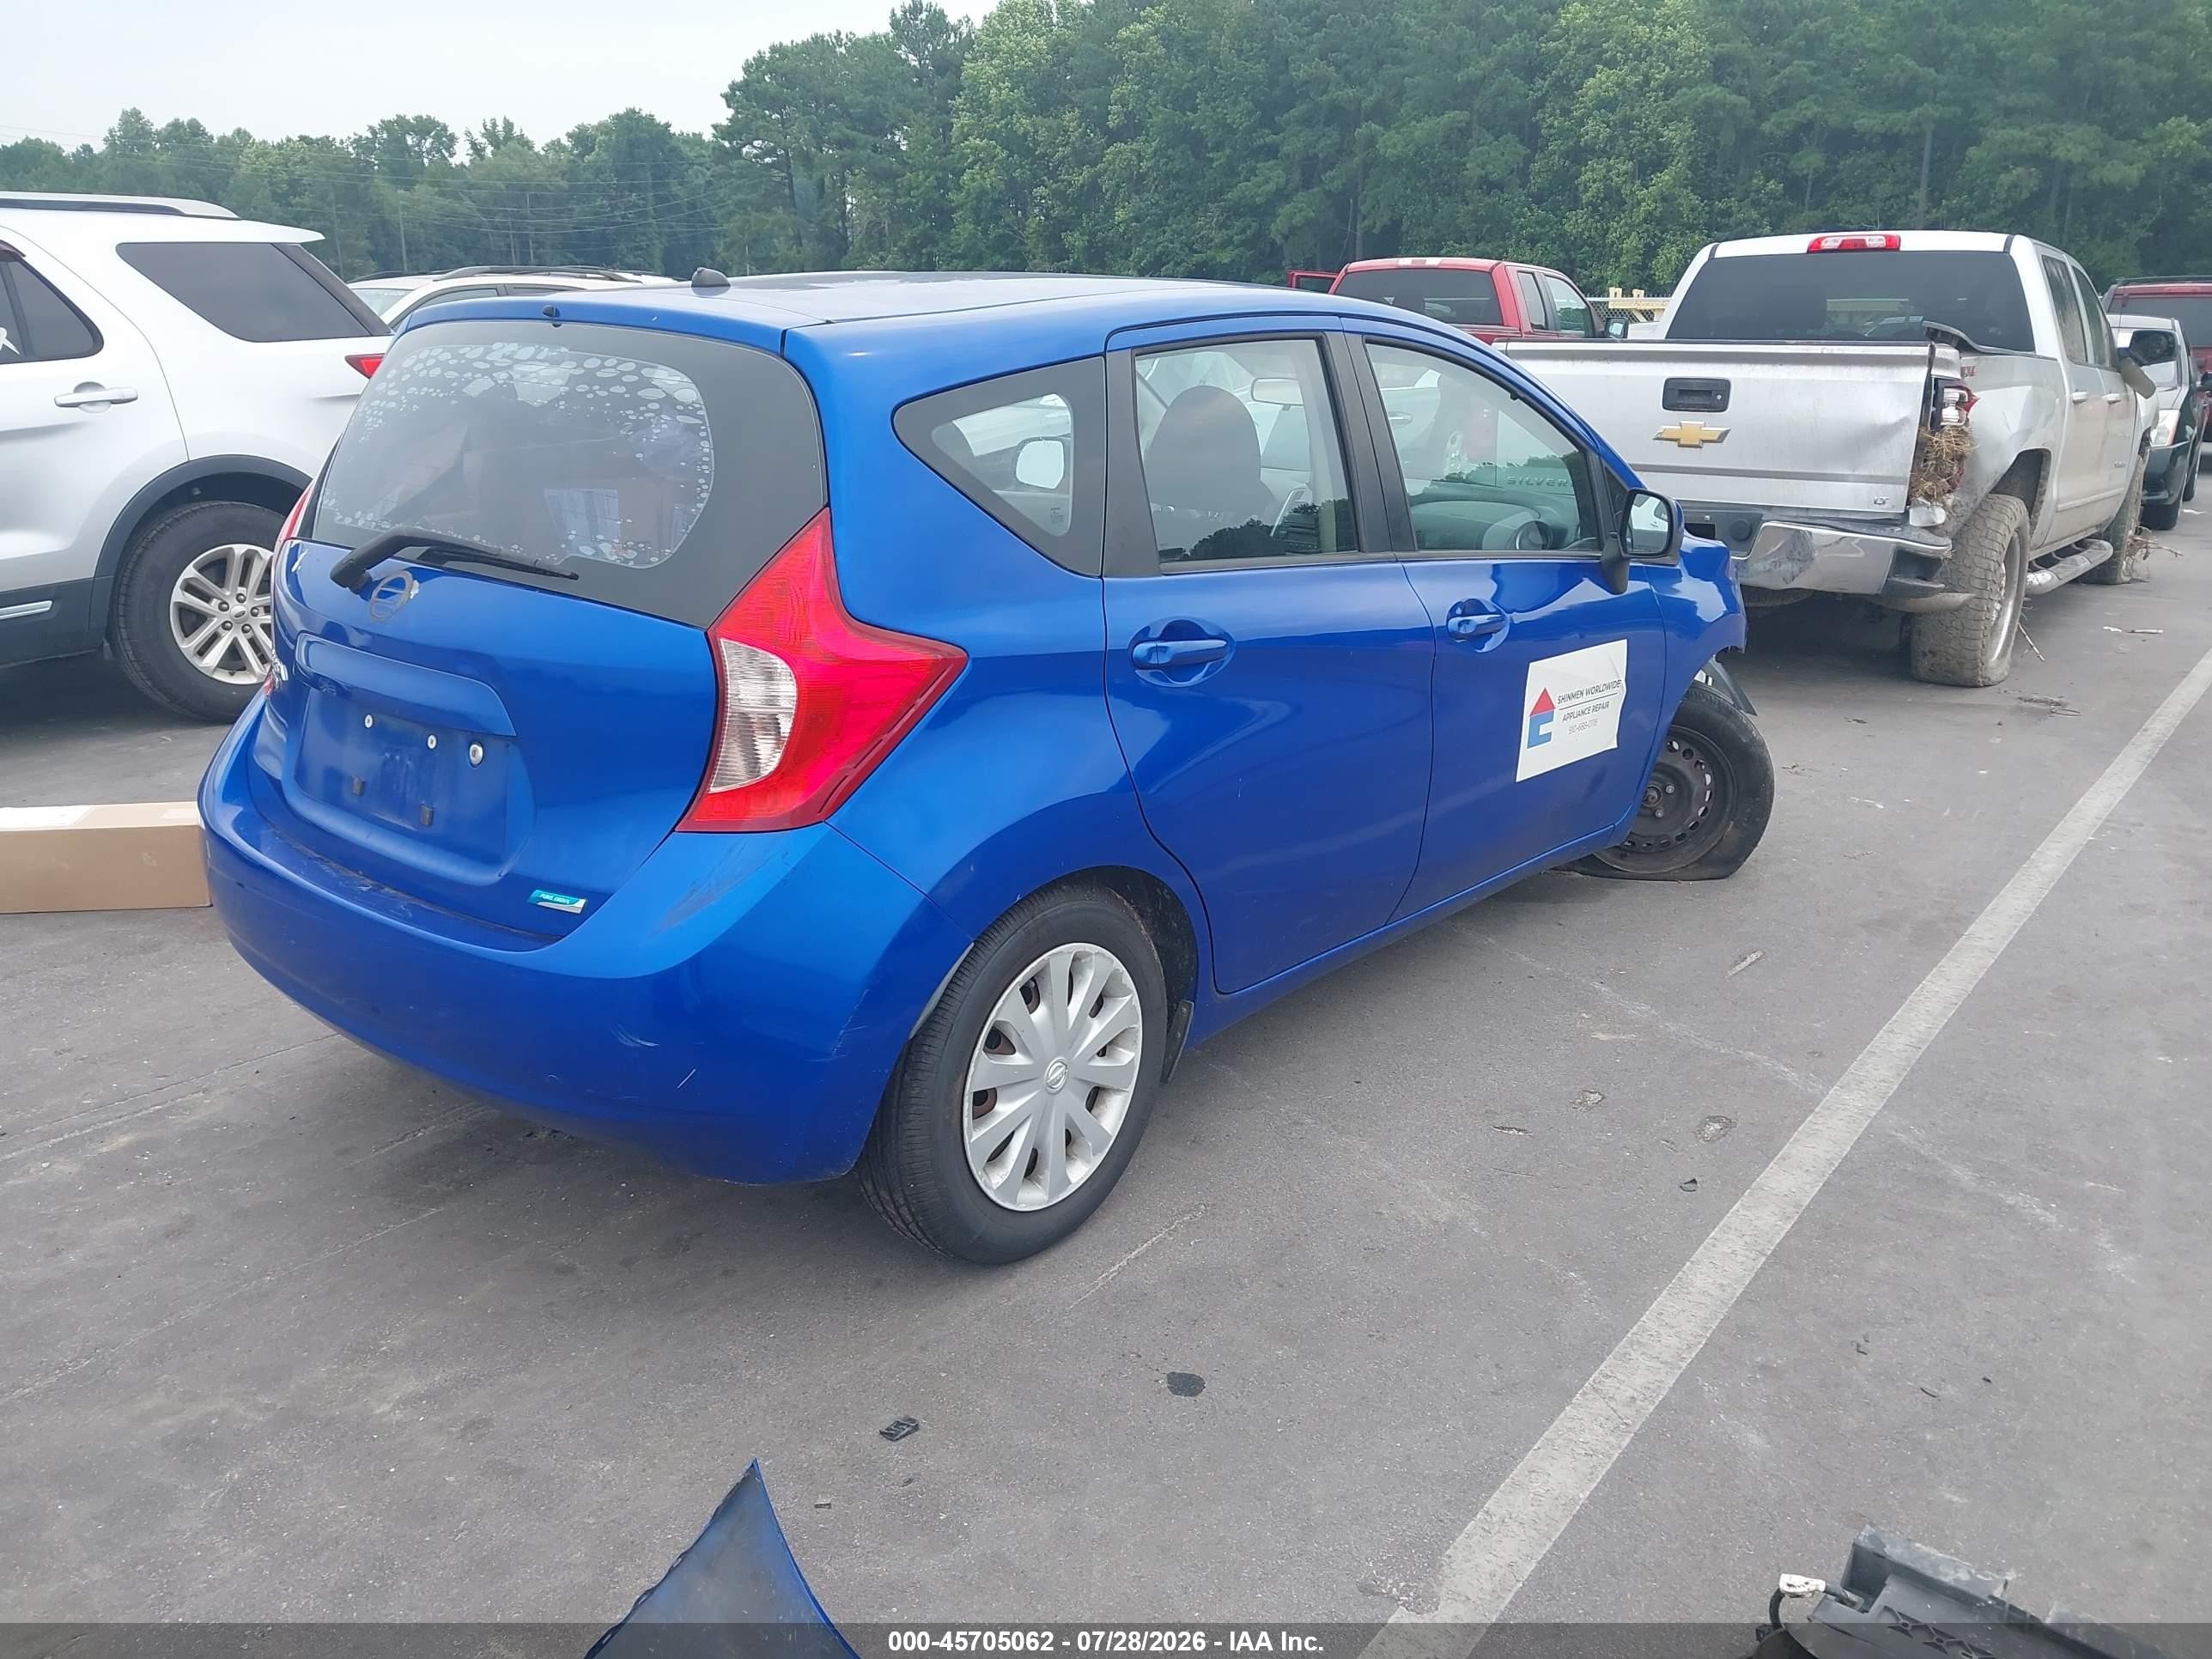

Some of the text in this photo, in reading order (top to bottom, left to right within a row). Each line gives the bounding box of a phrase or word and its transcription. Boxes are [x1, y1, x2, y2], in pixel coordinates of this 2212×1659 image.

[1507, 476, 1573, 488] SILVER
[1874, 495, 1889, 505] LT
[1558, 679, 1621, 704] SHINMEN WORLDWIDE
[1563, 701, 1610, 721] APPLIANCE REPAIR
